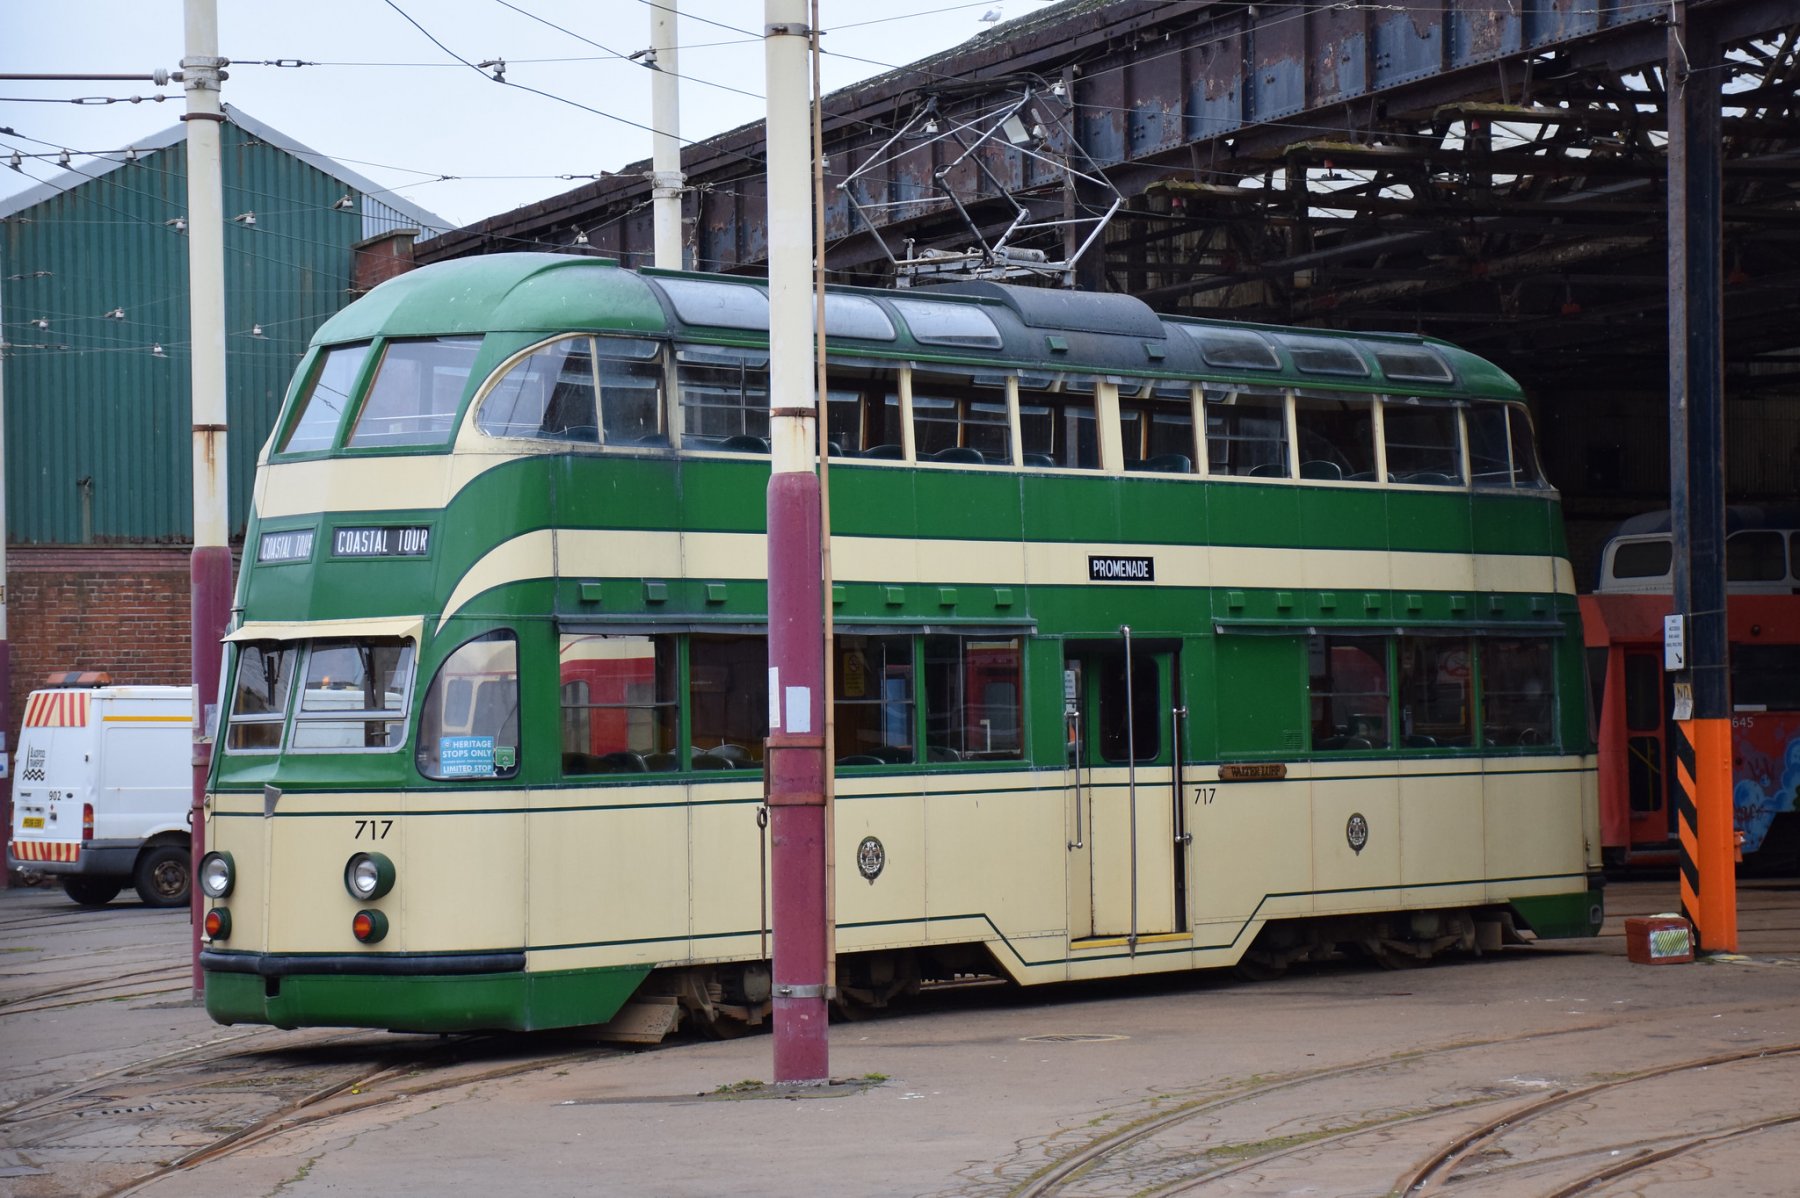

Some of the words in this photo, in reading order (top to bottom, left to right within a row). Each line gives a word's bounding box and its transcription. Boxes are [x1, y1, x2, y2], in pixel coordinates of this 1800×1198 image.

[262, 537, 291, 559] COASTAL
[338, 530, 388, 553] COASTAL
[398, 529, 428, 552] TOUR
[1093, 559, 1149, 577] PROMENADE
[1732, 717, 1754, 729] 645
[442, 750, 469, 758] STOPS
[443, 765, 472, 773] LIMITED
[48, 791, 62, 801] 902
[1195, 788, 1216, 805] 717
[355, 820, 393, 840] 717
